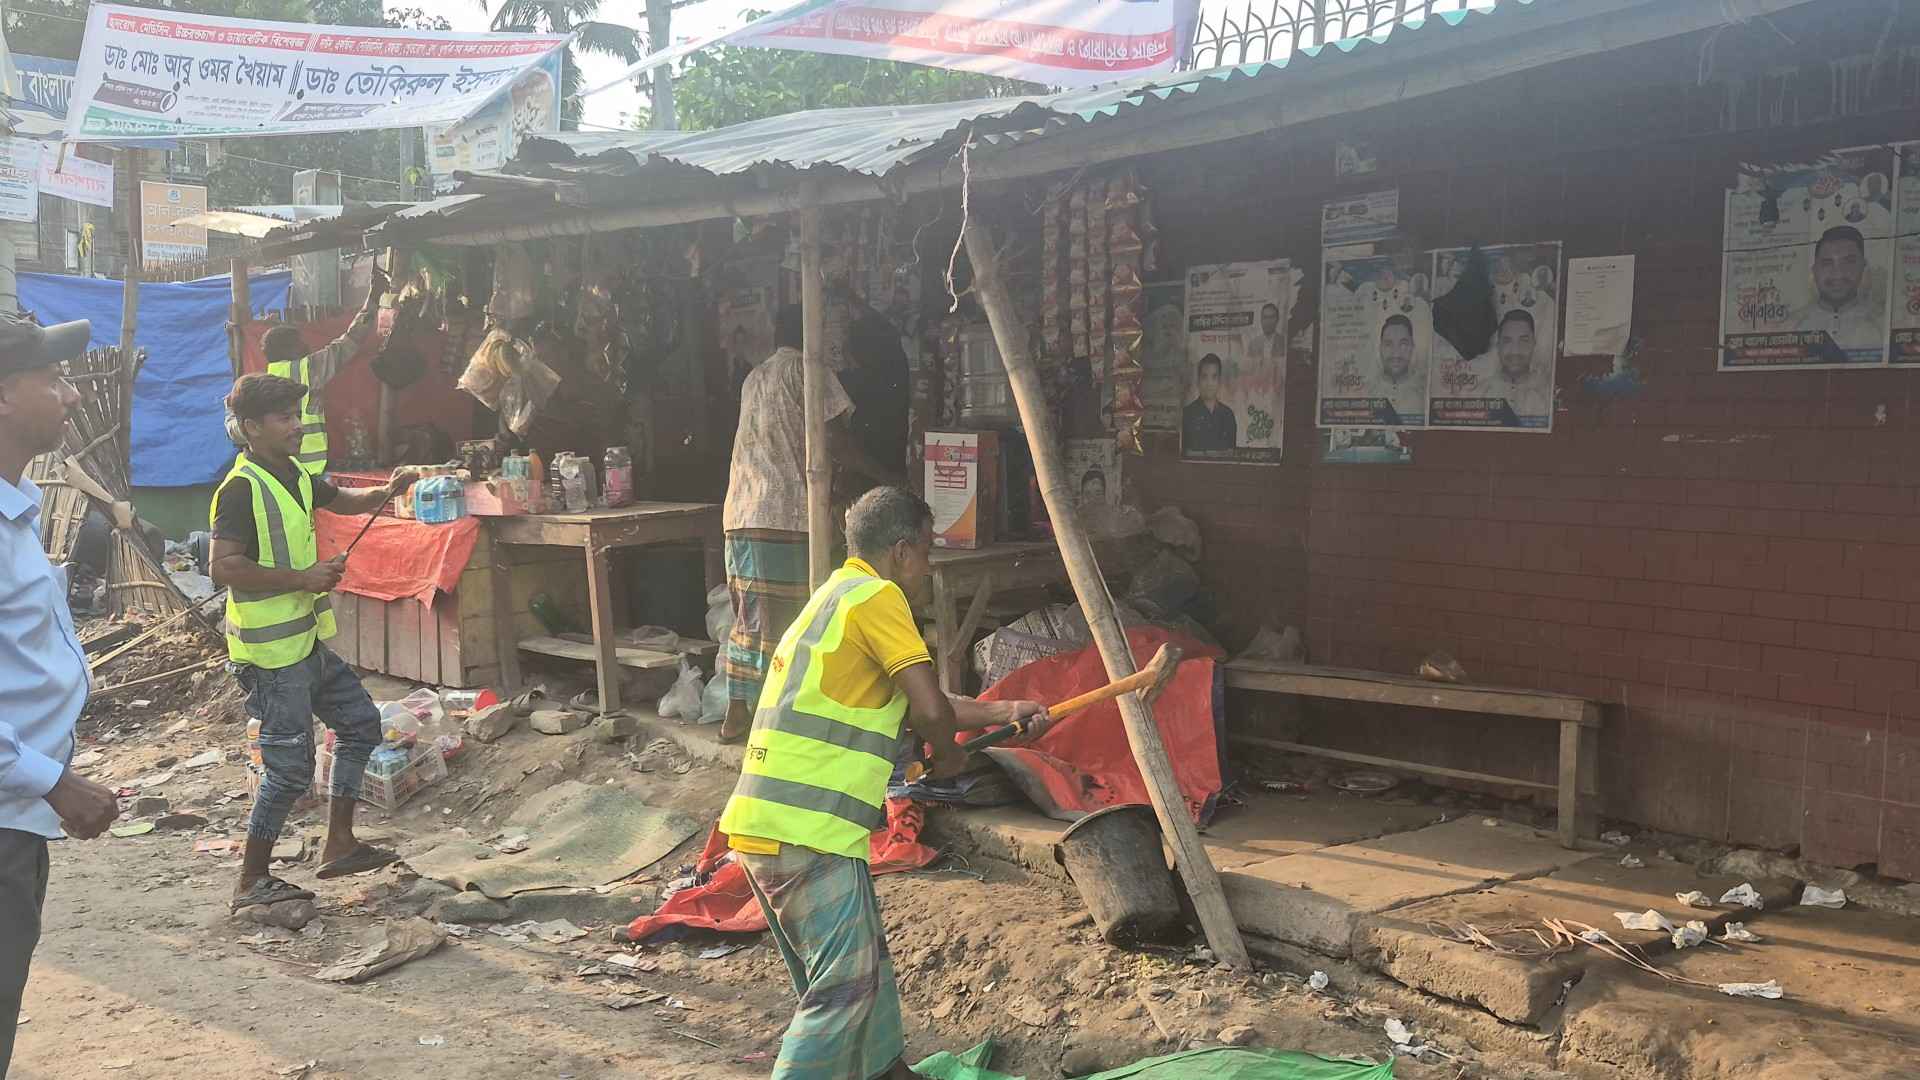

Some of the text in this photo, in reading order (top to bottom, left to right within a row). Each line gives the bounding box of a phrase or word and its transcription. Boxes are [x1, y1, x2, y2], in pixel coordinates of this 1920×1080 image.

[104, 45, 288, 89] ডাঃ মোঃ আবু ওমর খৈয়াম
[305, 67, 340, 96] ডাঃ
[344, 64, 450, 96] তৌকিরুল
